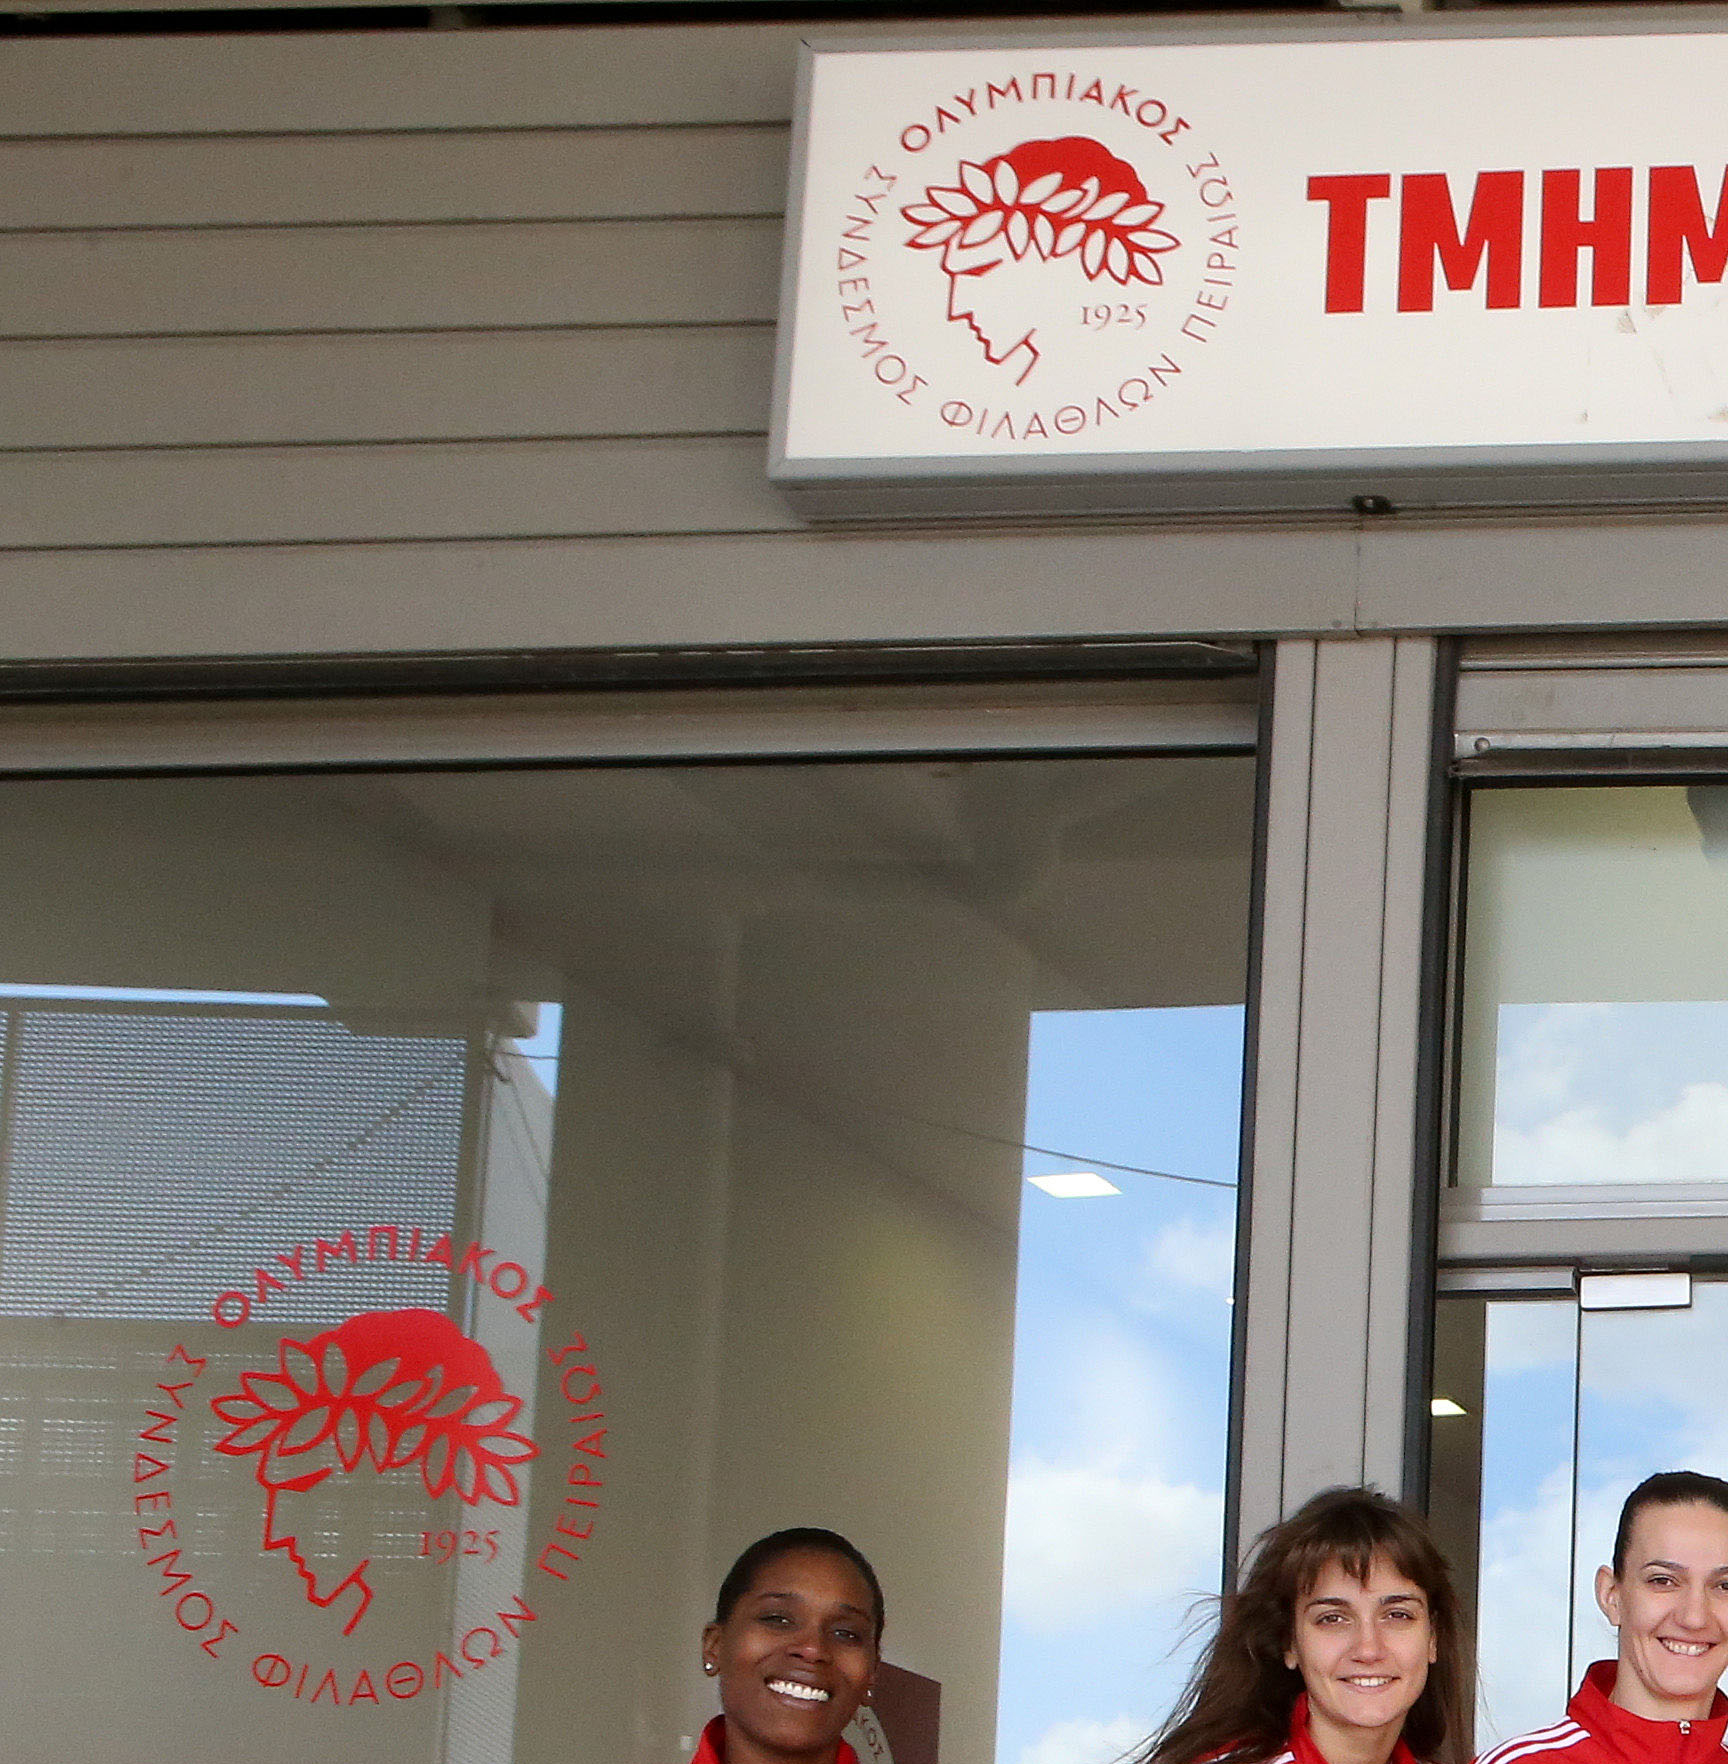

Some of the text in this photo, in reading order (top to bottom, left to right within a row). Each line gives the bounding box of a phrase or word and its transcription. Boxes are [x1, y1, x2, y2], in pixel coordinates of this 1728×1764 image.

[900, 72, 1191, 153] ΟΛΥΜΠΙΑΚΟΣ
[1079, 300, 1147, 332] 1925
[213, 1226, 555, 1328] ΟΛΥΜΠΙΑΚΟΣ
[134, 1331, 607, 1705] ΣΥΝΔΕΣΜΟΣ ΦΙΛΑΘΛΩΝ ΠΕΙΡΑΙΩΣ
[421, 1530, 501, 1565] 1925
